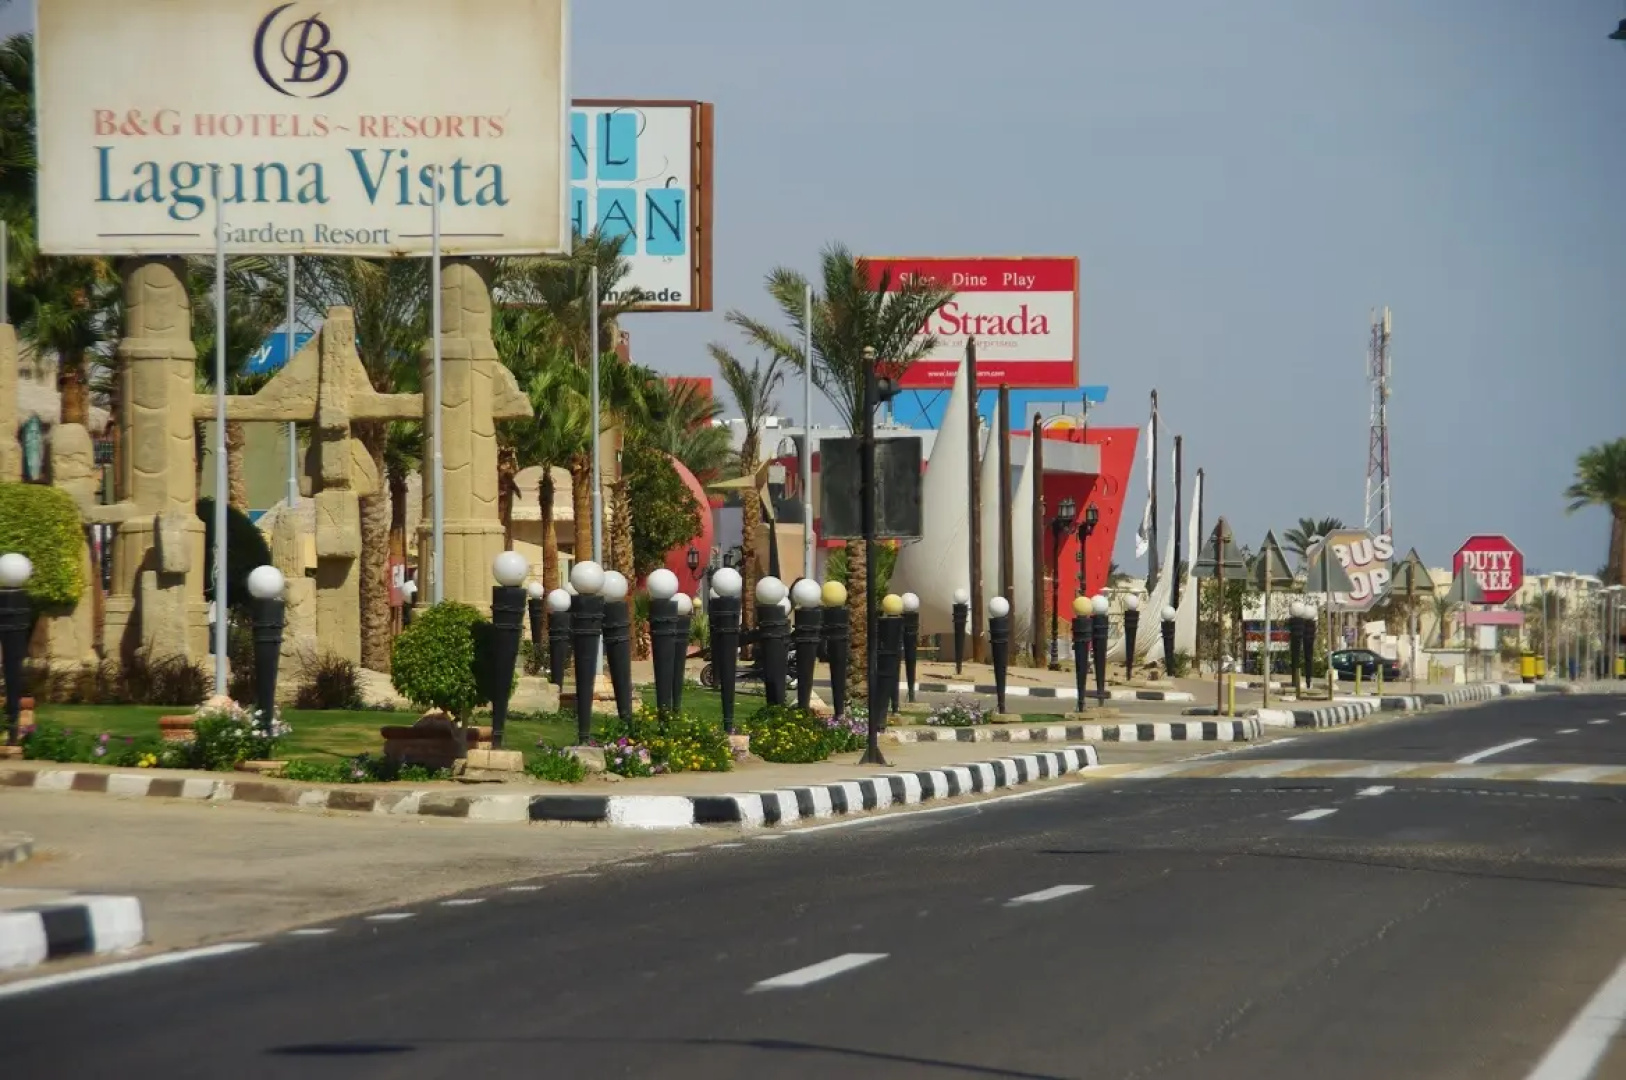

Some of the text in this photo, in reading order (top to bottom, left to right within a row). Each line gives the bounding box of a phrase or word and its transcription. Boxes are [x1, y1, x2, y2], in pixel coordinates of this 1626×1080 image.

[94, 109, 182, 137] B&G
[359, 115, 505, 138] RESORTS
[92, 145, 510, 221] Laguna Vista
[314, 223, 390, 245] Resort
[952, 272, 988, 286] Dine
[1003, 272, 1036, 288] Play
[1331, 535, 1394, 568] BUS
[1462, 550, 1514, 570] DUTY
